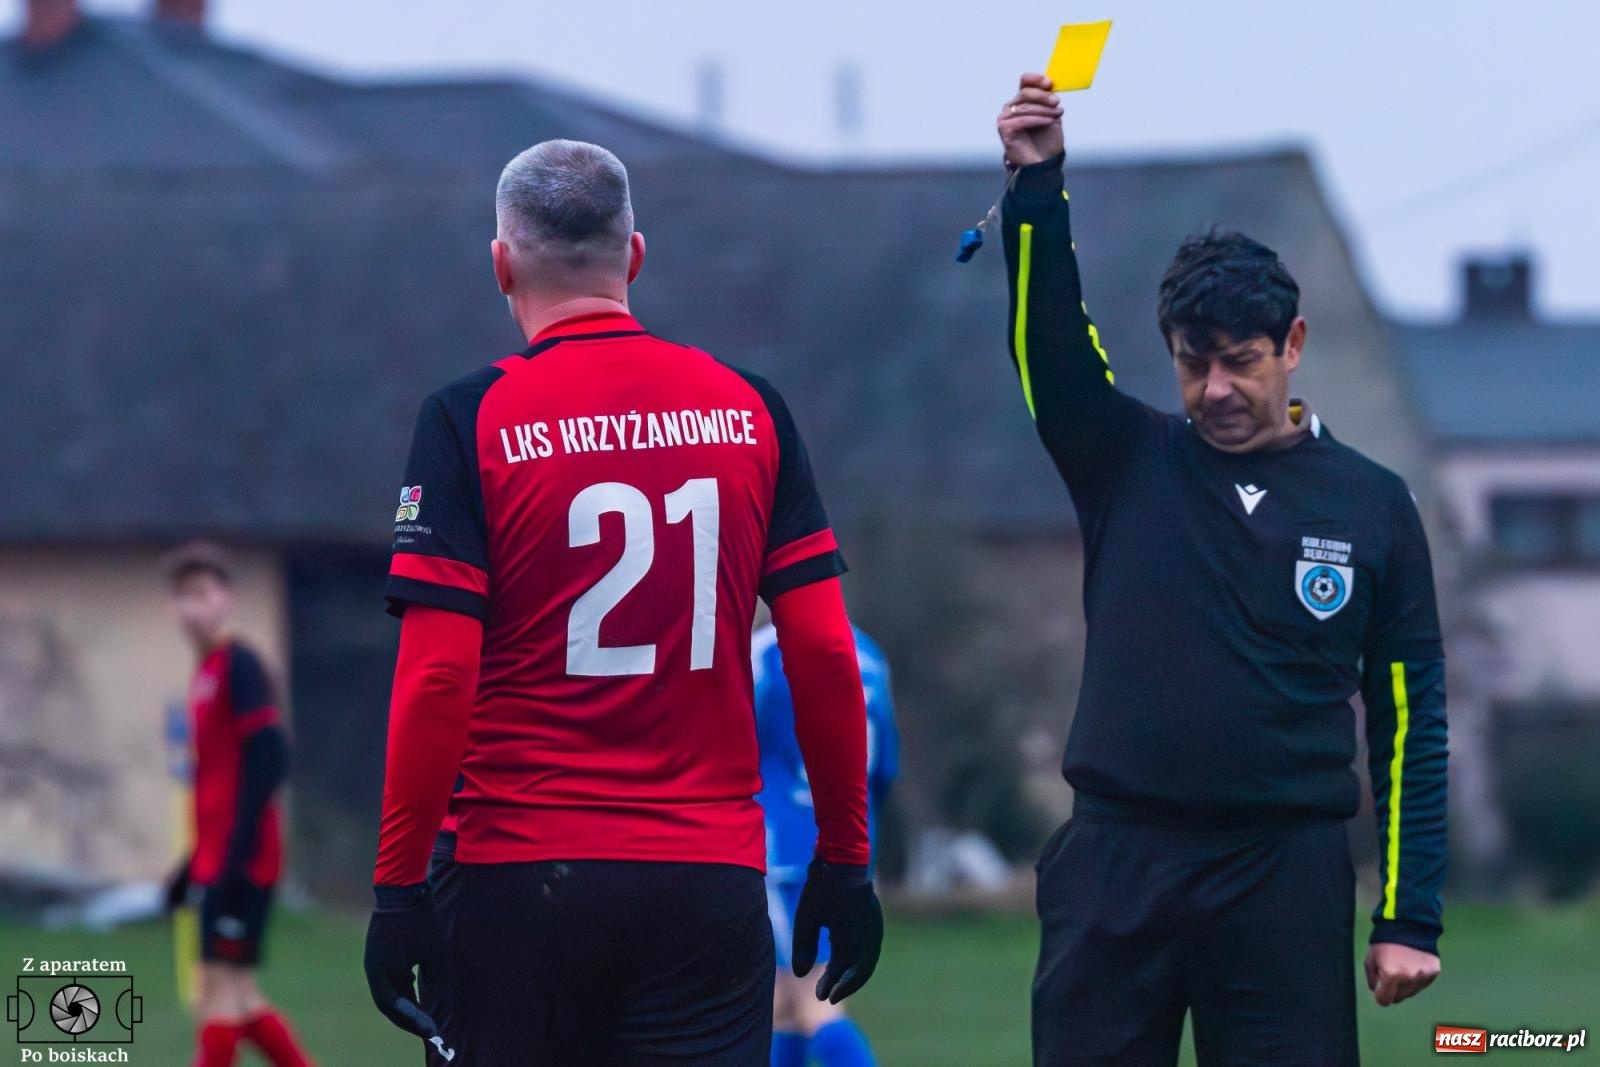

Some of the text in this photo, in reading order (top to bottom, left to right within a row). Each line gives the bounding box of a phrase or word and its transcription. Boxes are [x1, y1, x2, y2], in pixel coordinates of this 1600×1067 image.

[500, 409, 758, 464] LKS KRZYŻANOWICE
[566, 477, 719, 677] 21
